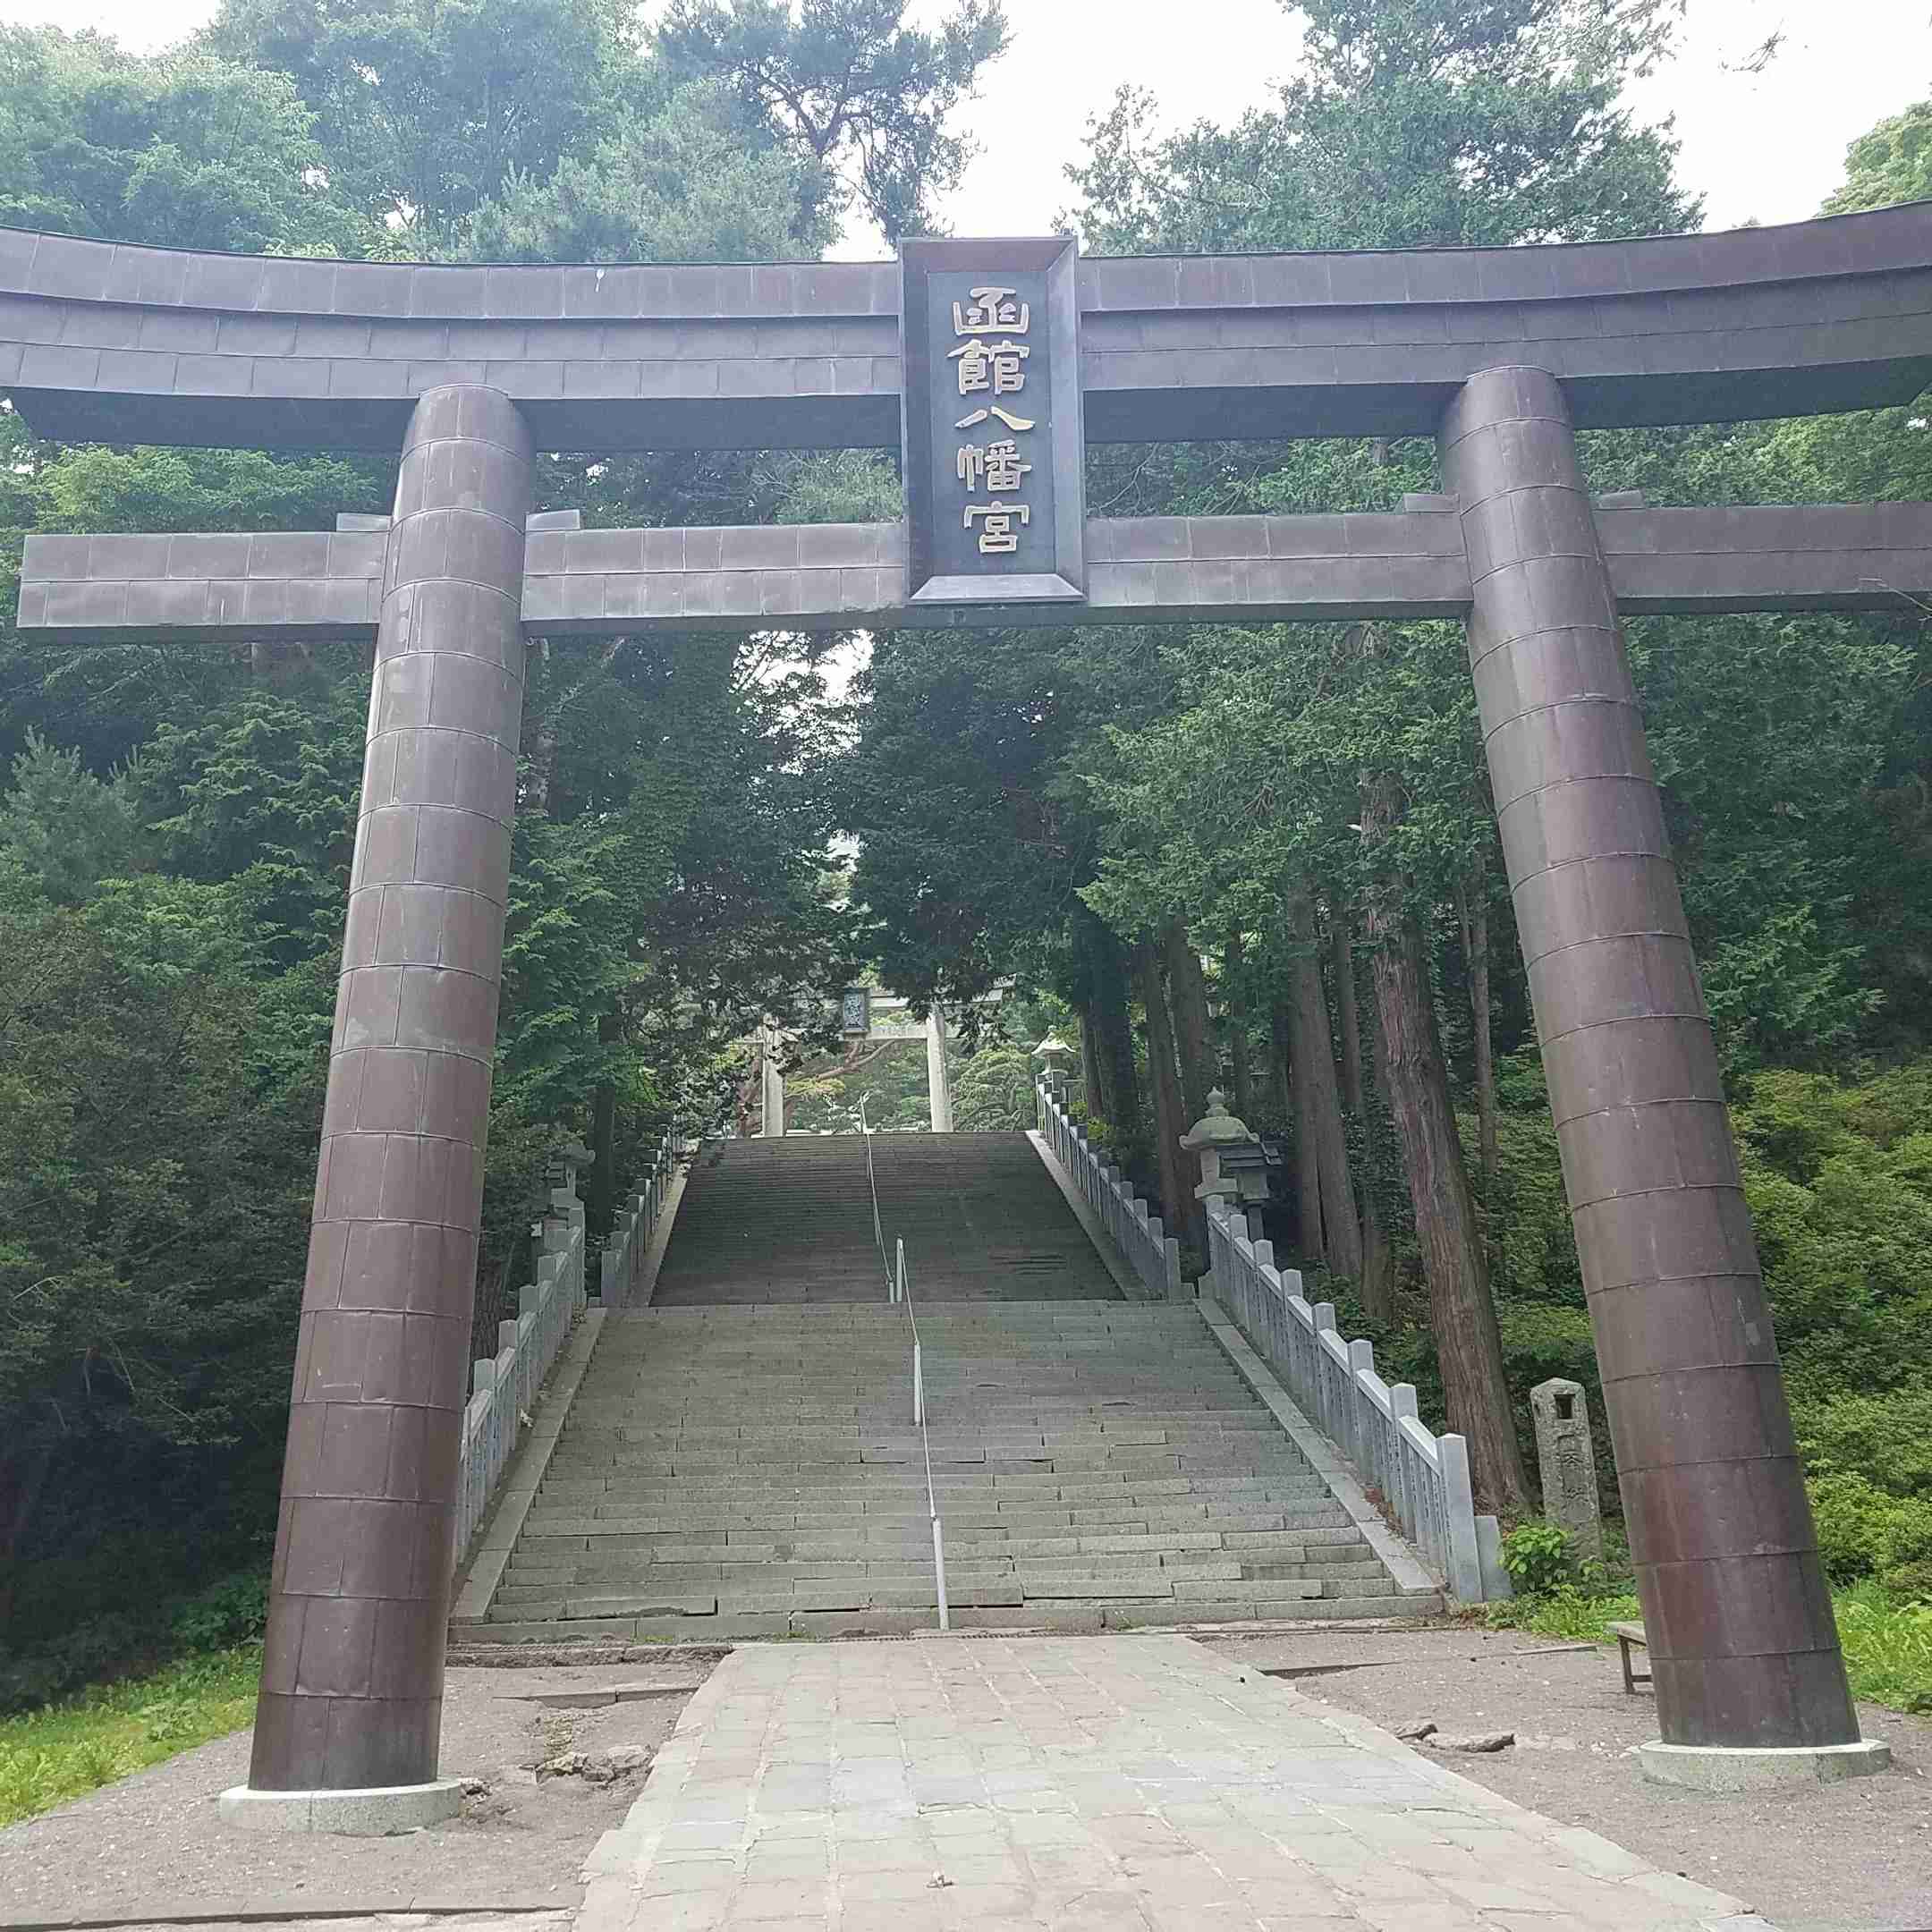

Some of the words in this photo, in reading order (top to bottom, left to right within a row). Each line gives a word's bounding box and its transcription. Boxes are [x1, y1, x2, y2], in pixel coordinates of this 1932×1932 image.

[946, 285, 1036, 554] 函館八幡宮
